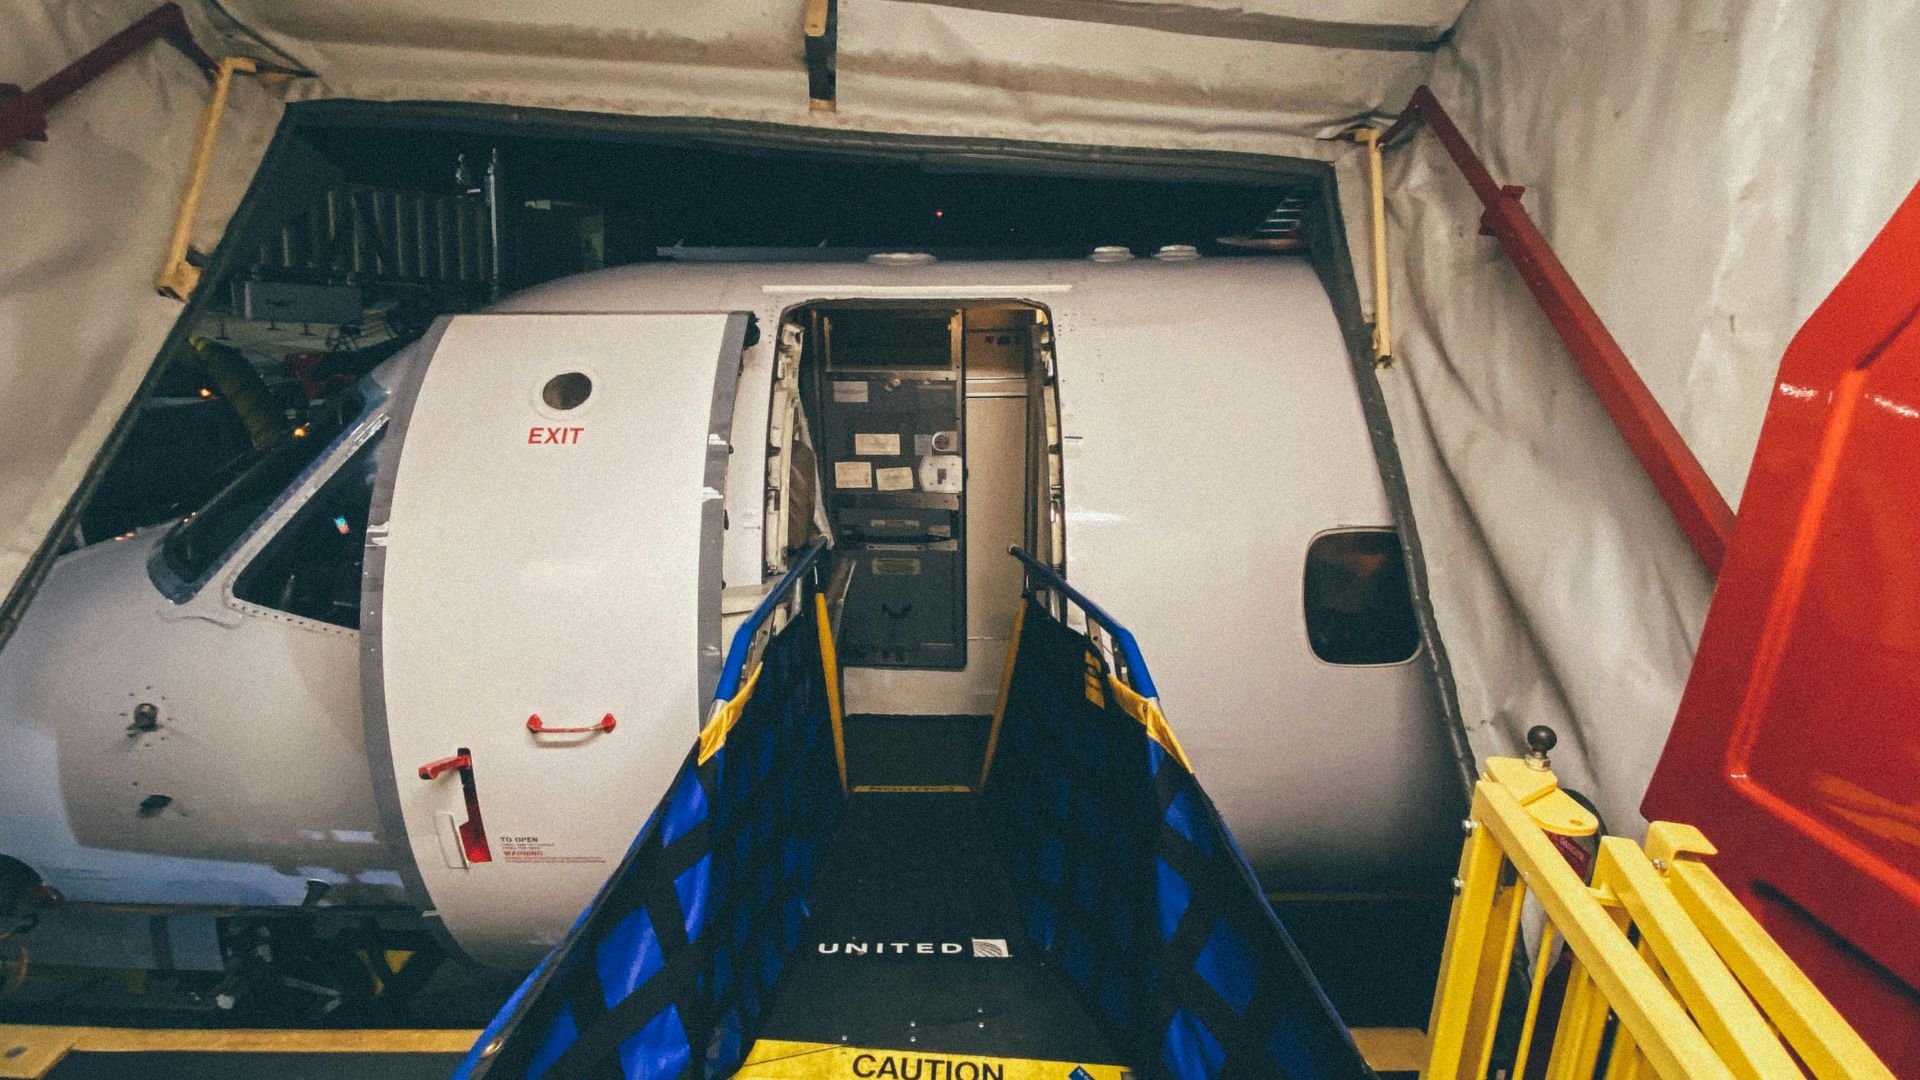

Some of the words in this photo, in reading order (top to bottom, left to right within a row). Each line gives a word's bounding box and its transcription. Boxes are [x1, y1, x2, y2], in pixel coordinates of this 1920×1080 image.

[528, 427, 584, 444] EXIT
[818, 942, 963, 954] UNITED
[852, 1053, 1004, 1080] CAUTION
